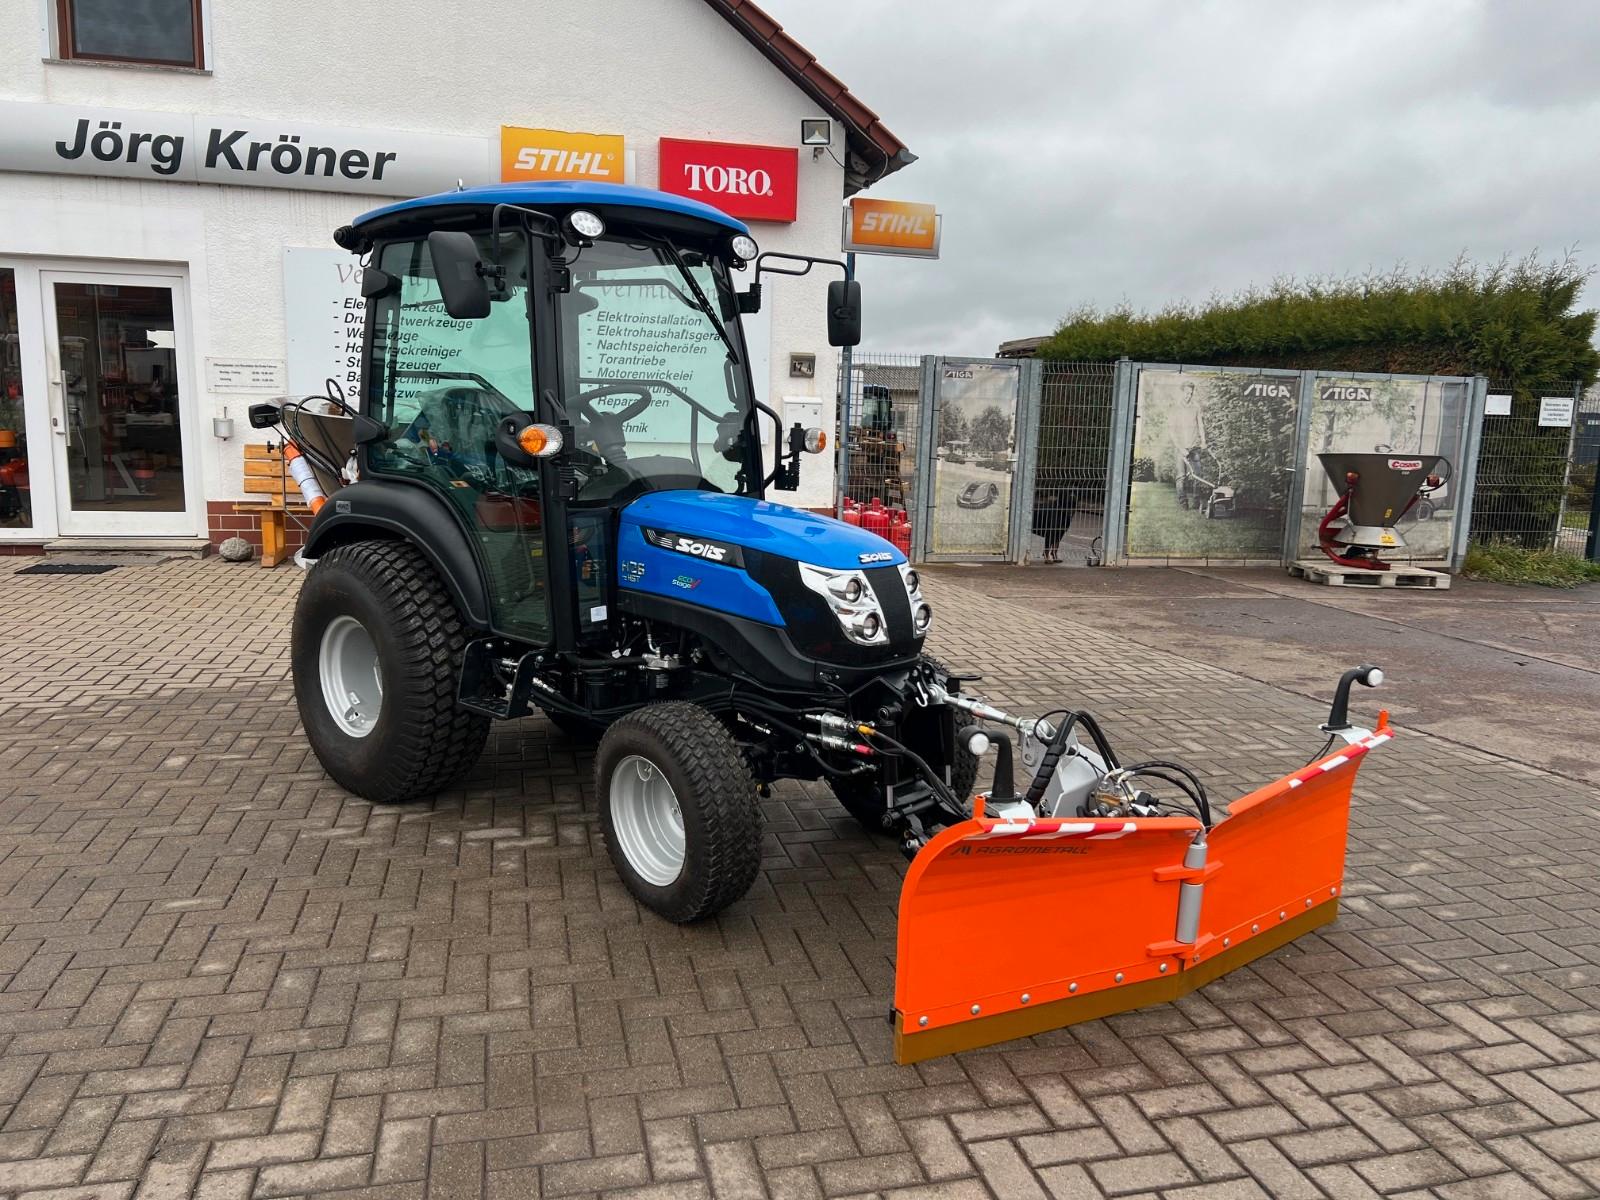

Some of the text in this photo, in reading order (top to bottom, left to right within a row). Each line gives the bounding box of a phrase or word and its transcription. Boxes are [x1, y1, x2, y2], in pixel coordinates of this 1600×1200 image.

[55, 118, 397, 181] Jörg Kröner
[514, 147, 610, 176] STIHL
[684, 163, 771, 196] TORO
[860, 211, 928, 235] STIHL
[597, 311, 702, 327] Elektroinstallation
[597, 339, 708, 355] Nachtspeicheröfen
[599, 353, 666, 366] Torantriebe
[597, 367, 694, 381] Motorenwickelei
[1244, 384, 1290, 398] STIGA
[1322, 388, 1370, 400] STIGA
